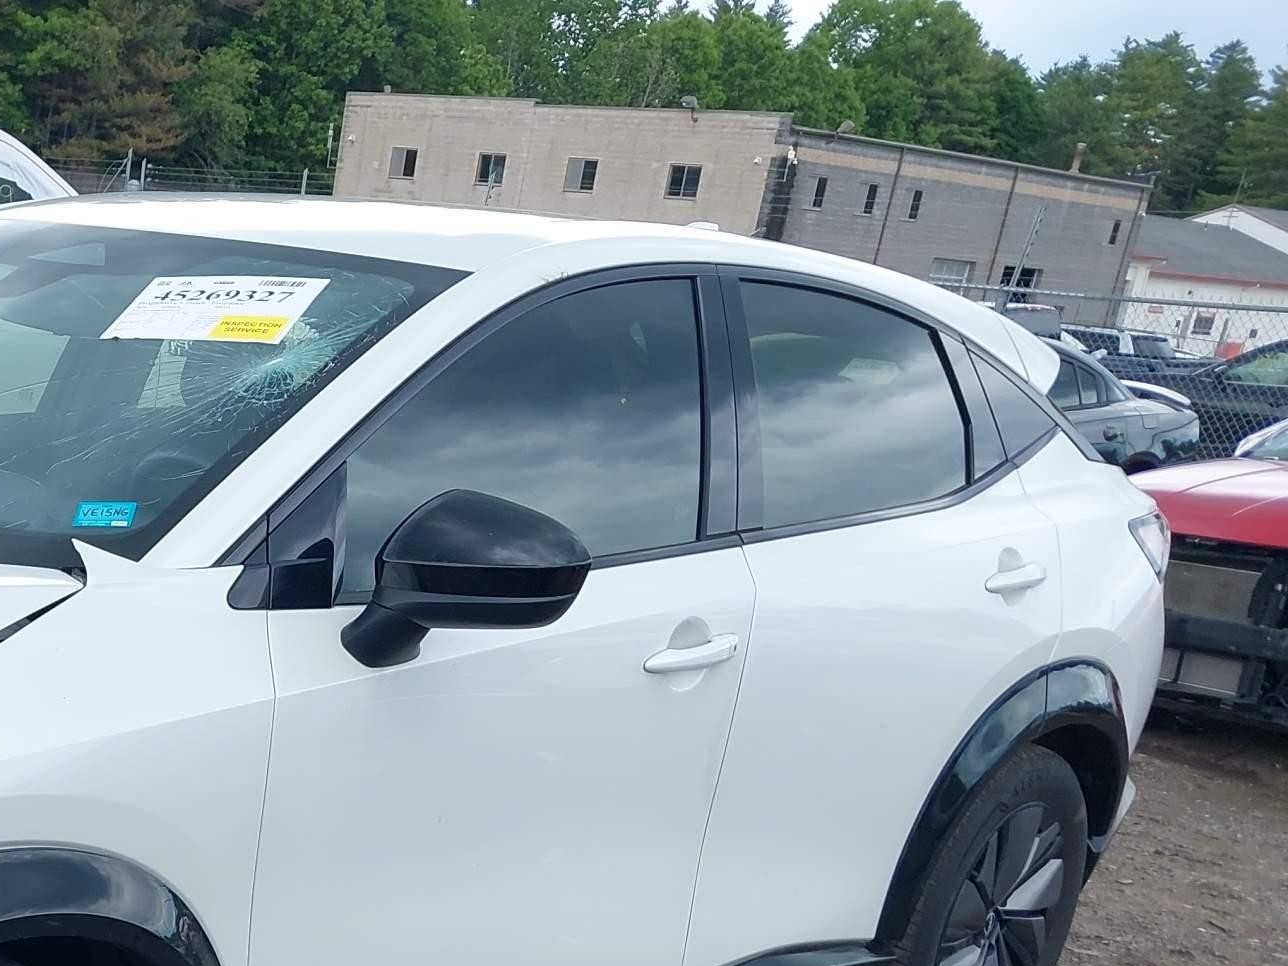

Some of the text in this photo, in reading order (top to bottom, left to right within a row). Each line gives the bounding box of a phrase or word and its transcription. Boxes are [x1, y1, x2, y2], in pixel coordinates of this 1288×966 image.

[154, 289, 296, 304] 45269327
[221, 320, 283, 328] INSPECTION
[224, 327, 270, 335] SERVICE
